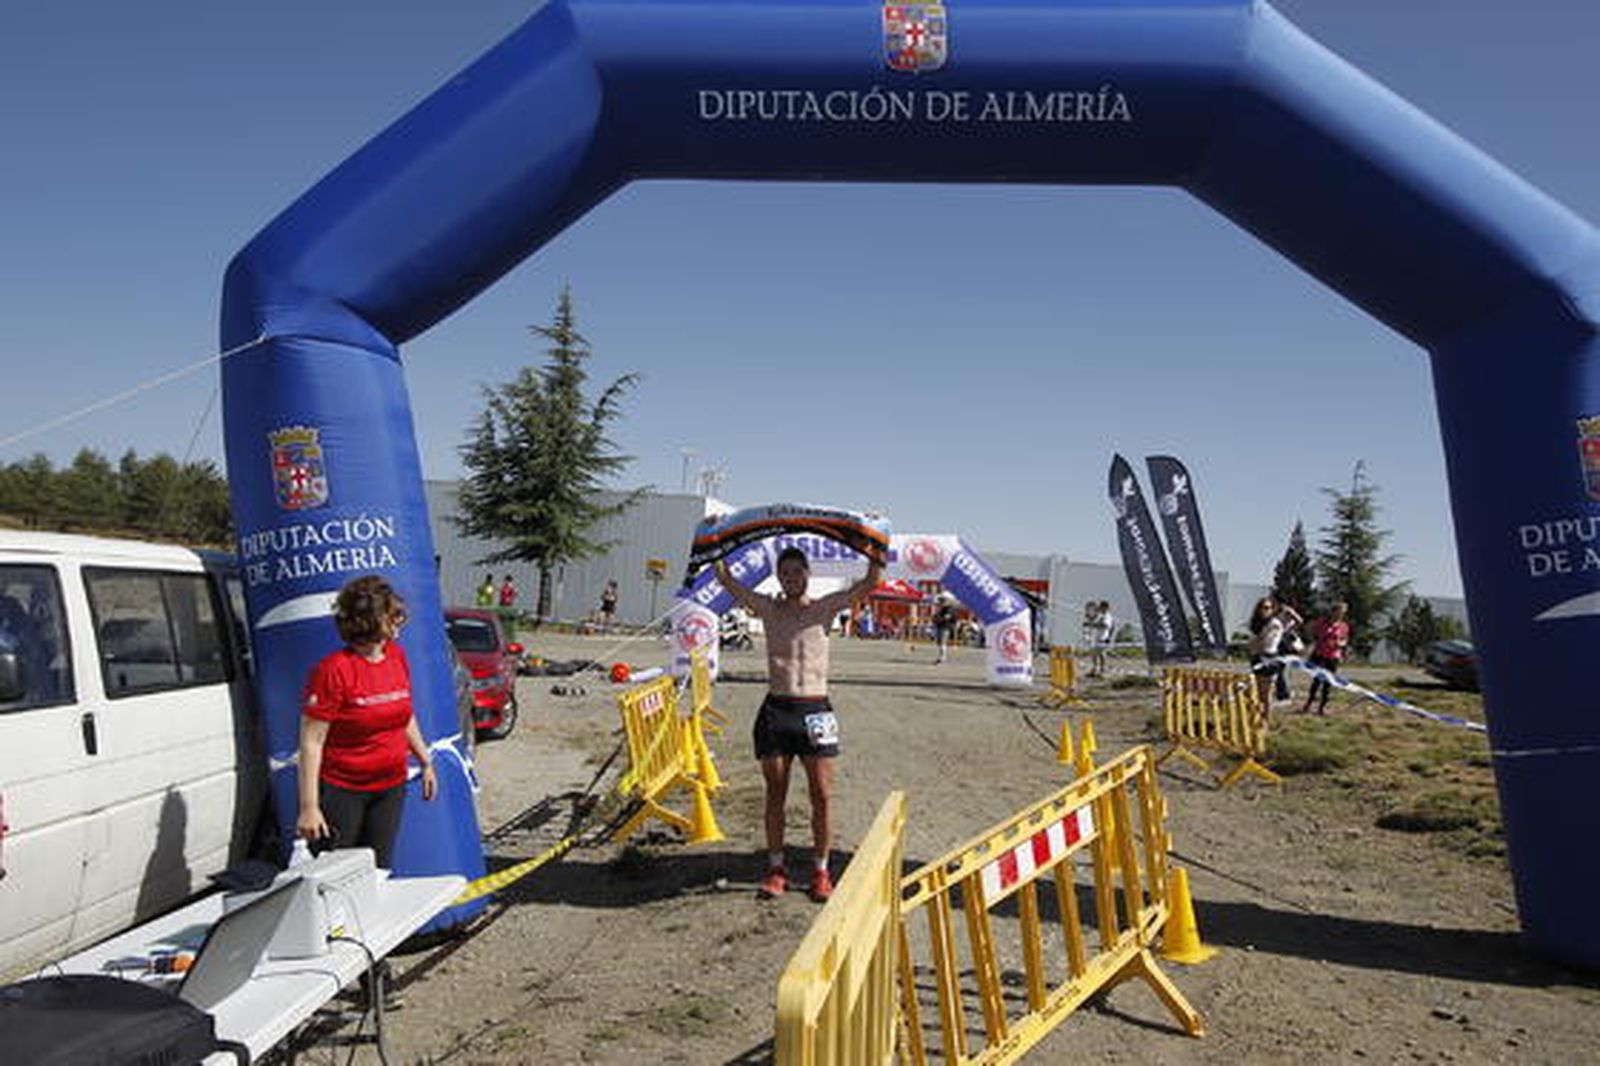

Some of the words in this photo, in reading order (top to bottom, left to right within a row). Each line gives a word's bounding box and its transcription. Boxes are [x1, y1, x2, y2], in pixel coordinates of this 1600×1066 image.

[699, 86, 914, 122] DIPUTACIÓN
[926, 91, 969, 122] DE
[979, 84, 1132, 122] ALMERÍA
[241, 513, 396, 559] DIPUTACIÓN
[247, 561, 272, 587] DE
[276, 542, 397, 581] ALMERÍA
[1528, 550, 1572, 576] DE
